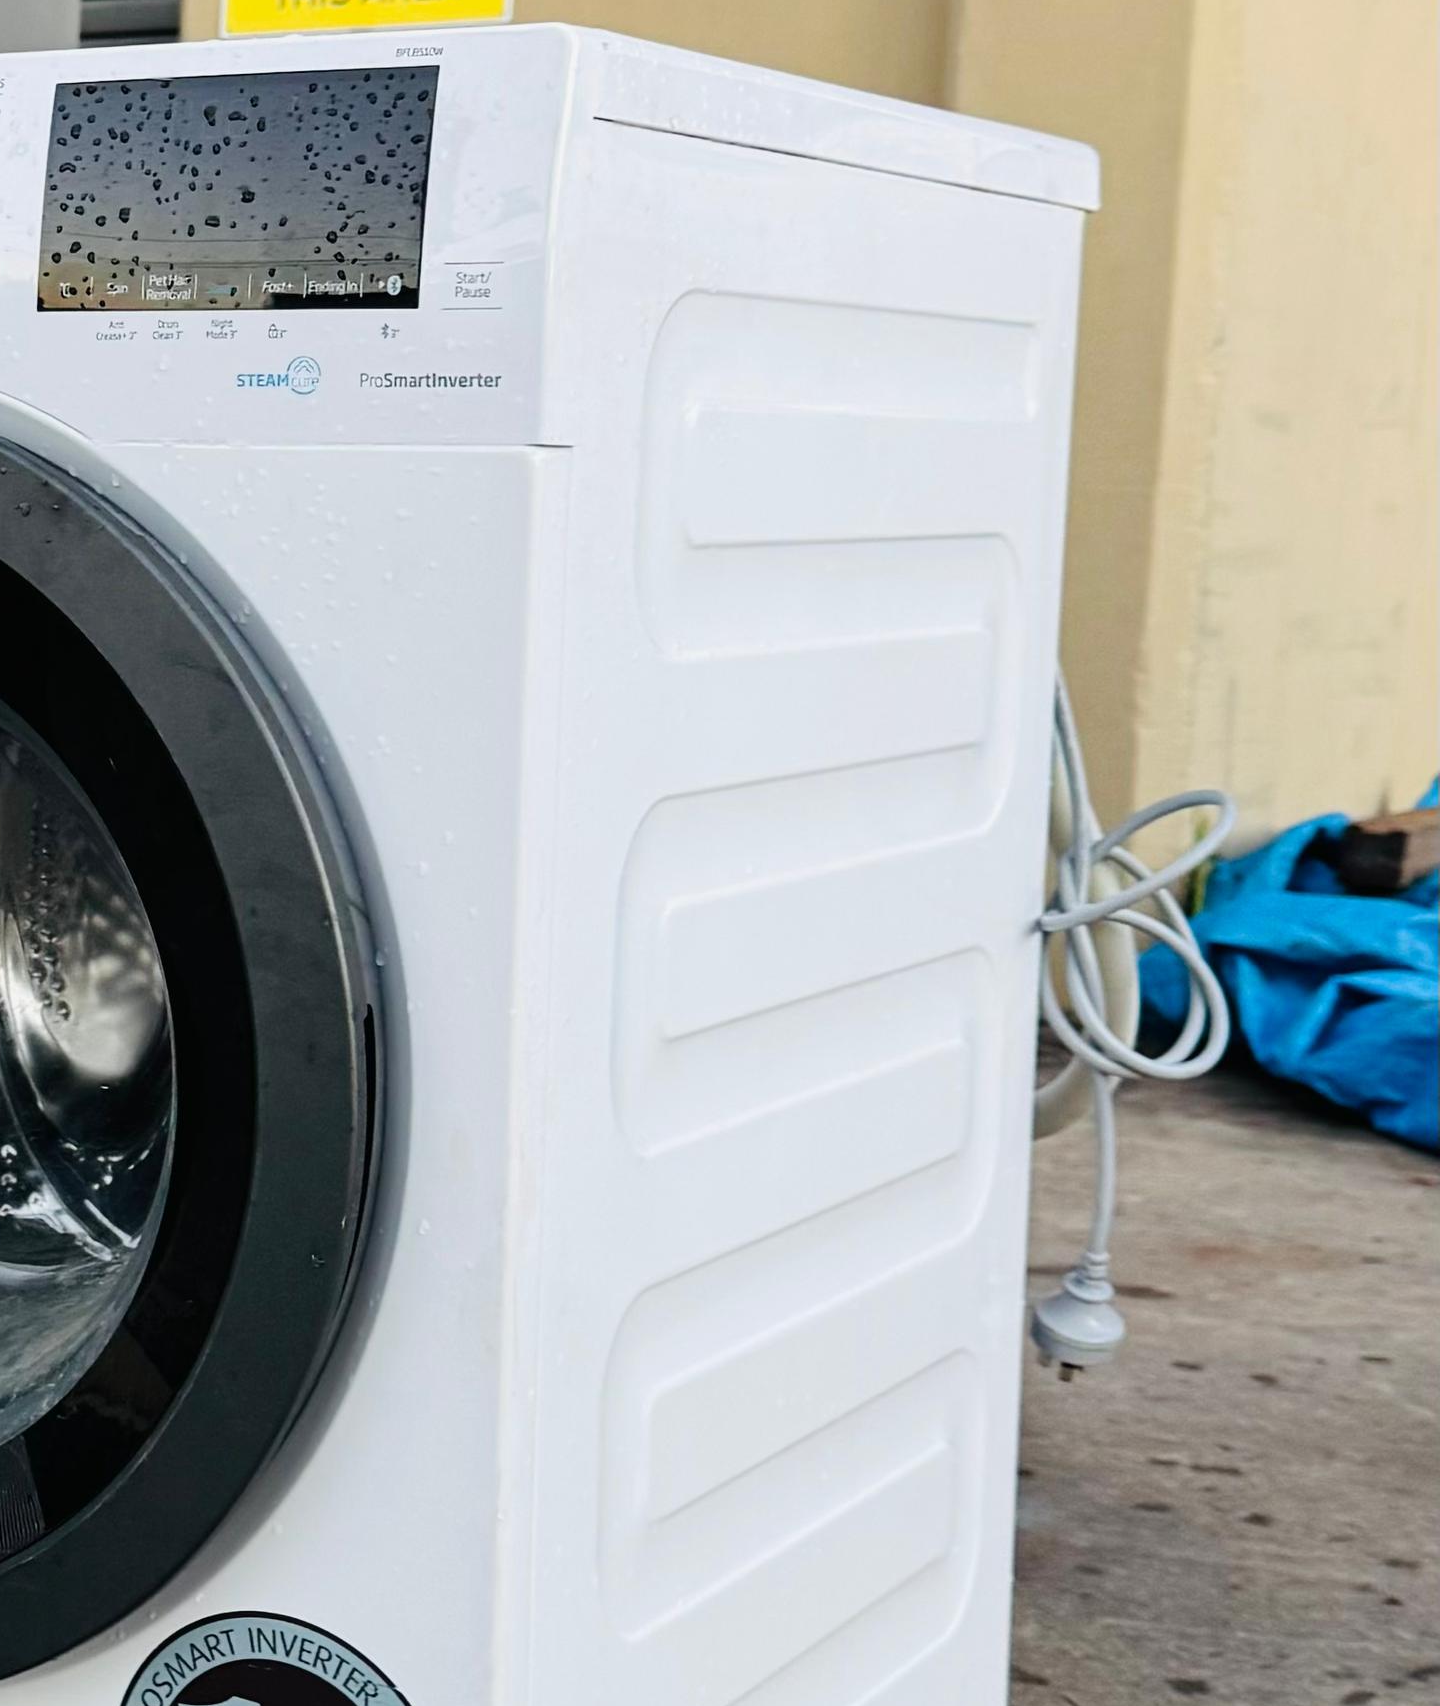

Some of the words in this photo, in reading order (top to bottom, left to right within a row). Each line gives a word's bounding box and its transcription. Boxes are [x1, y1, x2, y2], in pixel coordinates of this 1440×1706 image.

[456, 272, 492, 284] Start/
[262, 281, 294, 293] Fast+
[308, 280, 346, 295] Ending
[347, 281, 359, 293] In
[455, 286, 491, 298] Pause
[146, 288, 191, 300] Removal
[360, 373, 501, 388] ProSmartInverter
